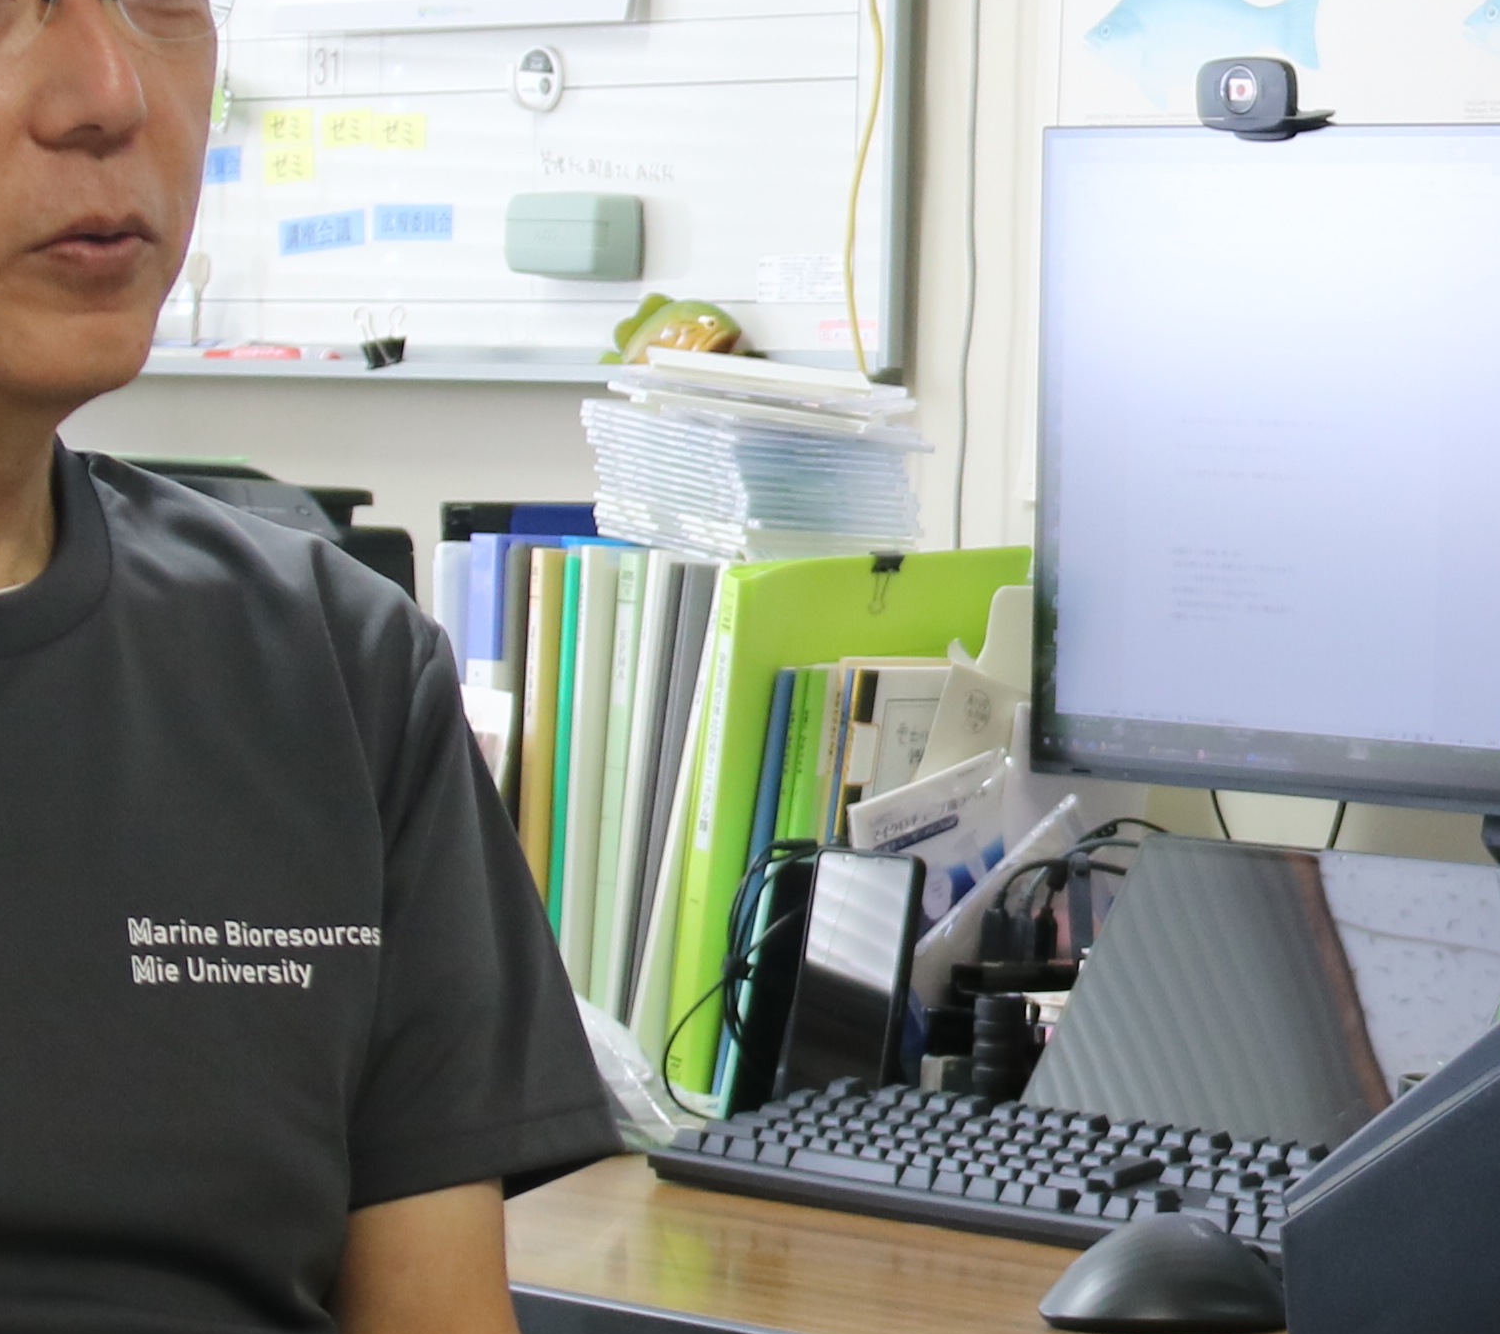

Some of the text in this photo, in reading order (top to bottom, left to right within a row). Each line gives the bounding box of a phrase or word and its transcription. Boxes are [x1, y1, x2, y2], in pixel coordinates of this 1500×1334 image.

[313, 46, 340, 86] 31
[269, 112, 303, 142] ゼミ
[330, 115, 365, 143] ゼミ
[381, 119, 414, 146] ゼミ
[269, 151, 305, 181] ゼミ
[283, 215, 354, 252] 講座会議
[127, 917, 382, 948] Marine Bioresources
[131, 954, 313, 989] Mie University
